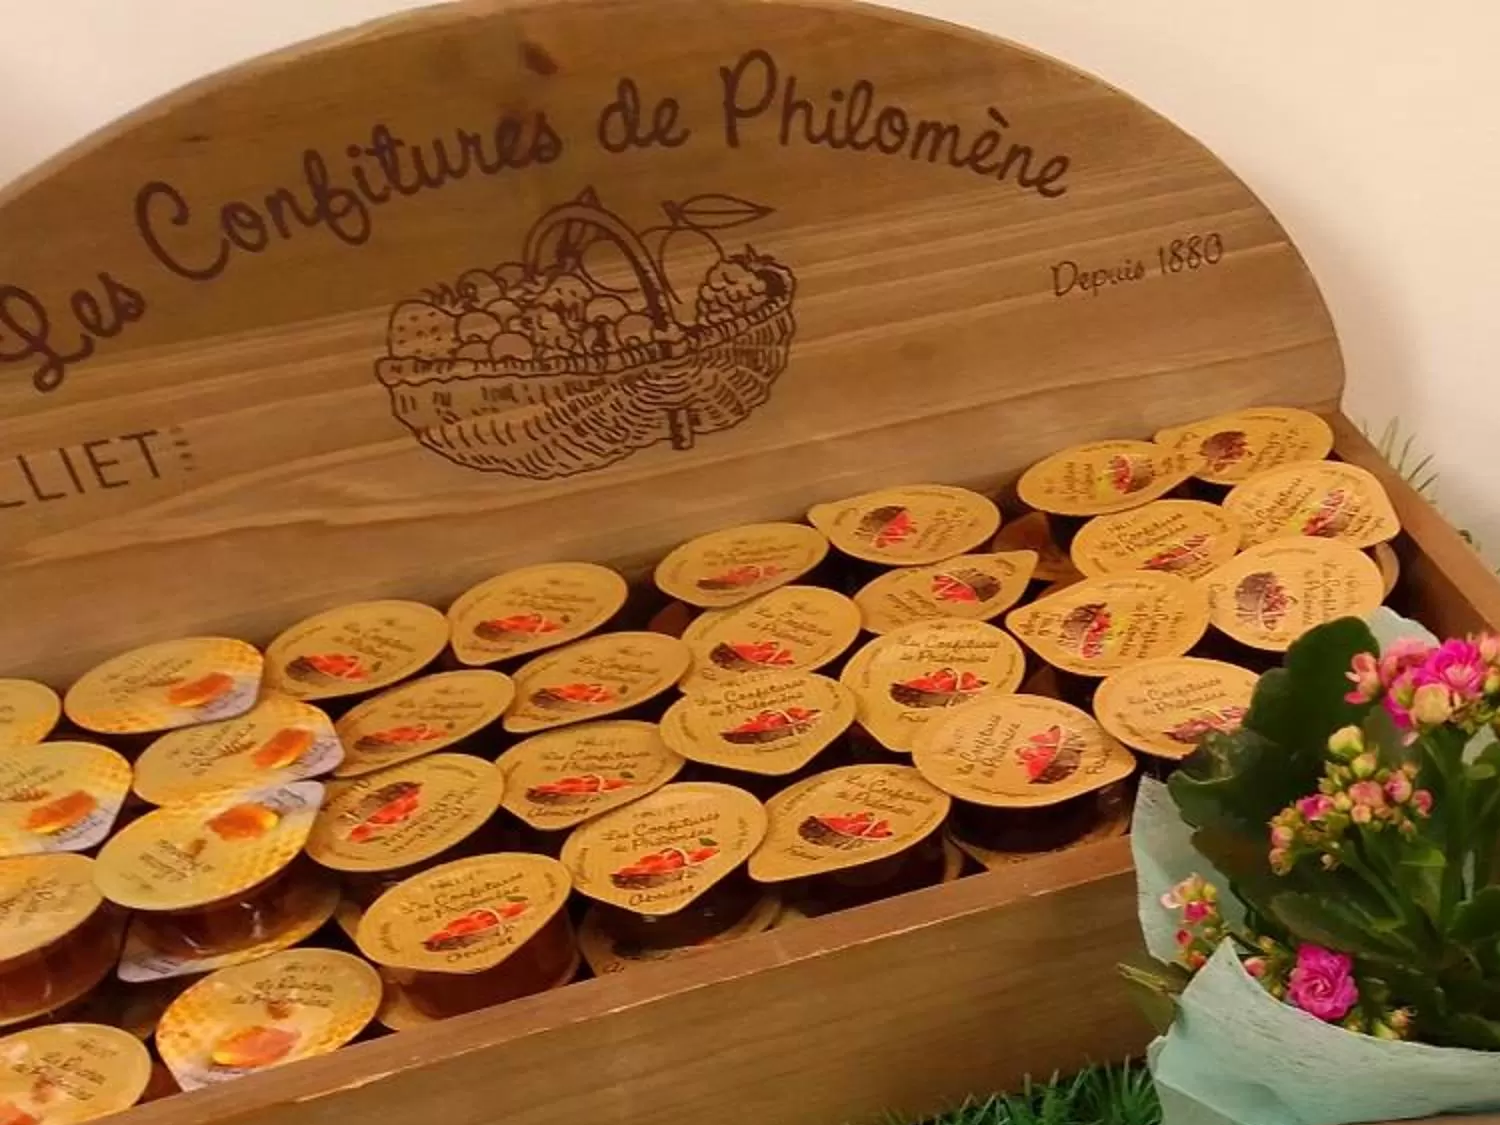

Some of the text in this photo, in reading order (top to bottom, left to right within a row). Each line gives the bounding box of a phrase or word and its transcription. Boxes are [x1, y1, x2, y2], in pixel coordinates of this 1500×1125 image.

[0, 48, 1071, 392] Les Confitures de Philomène
[1052, 232, 1224, 297] Depuis 1880
